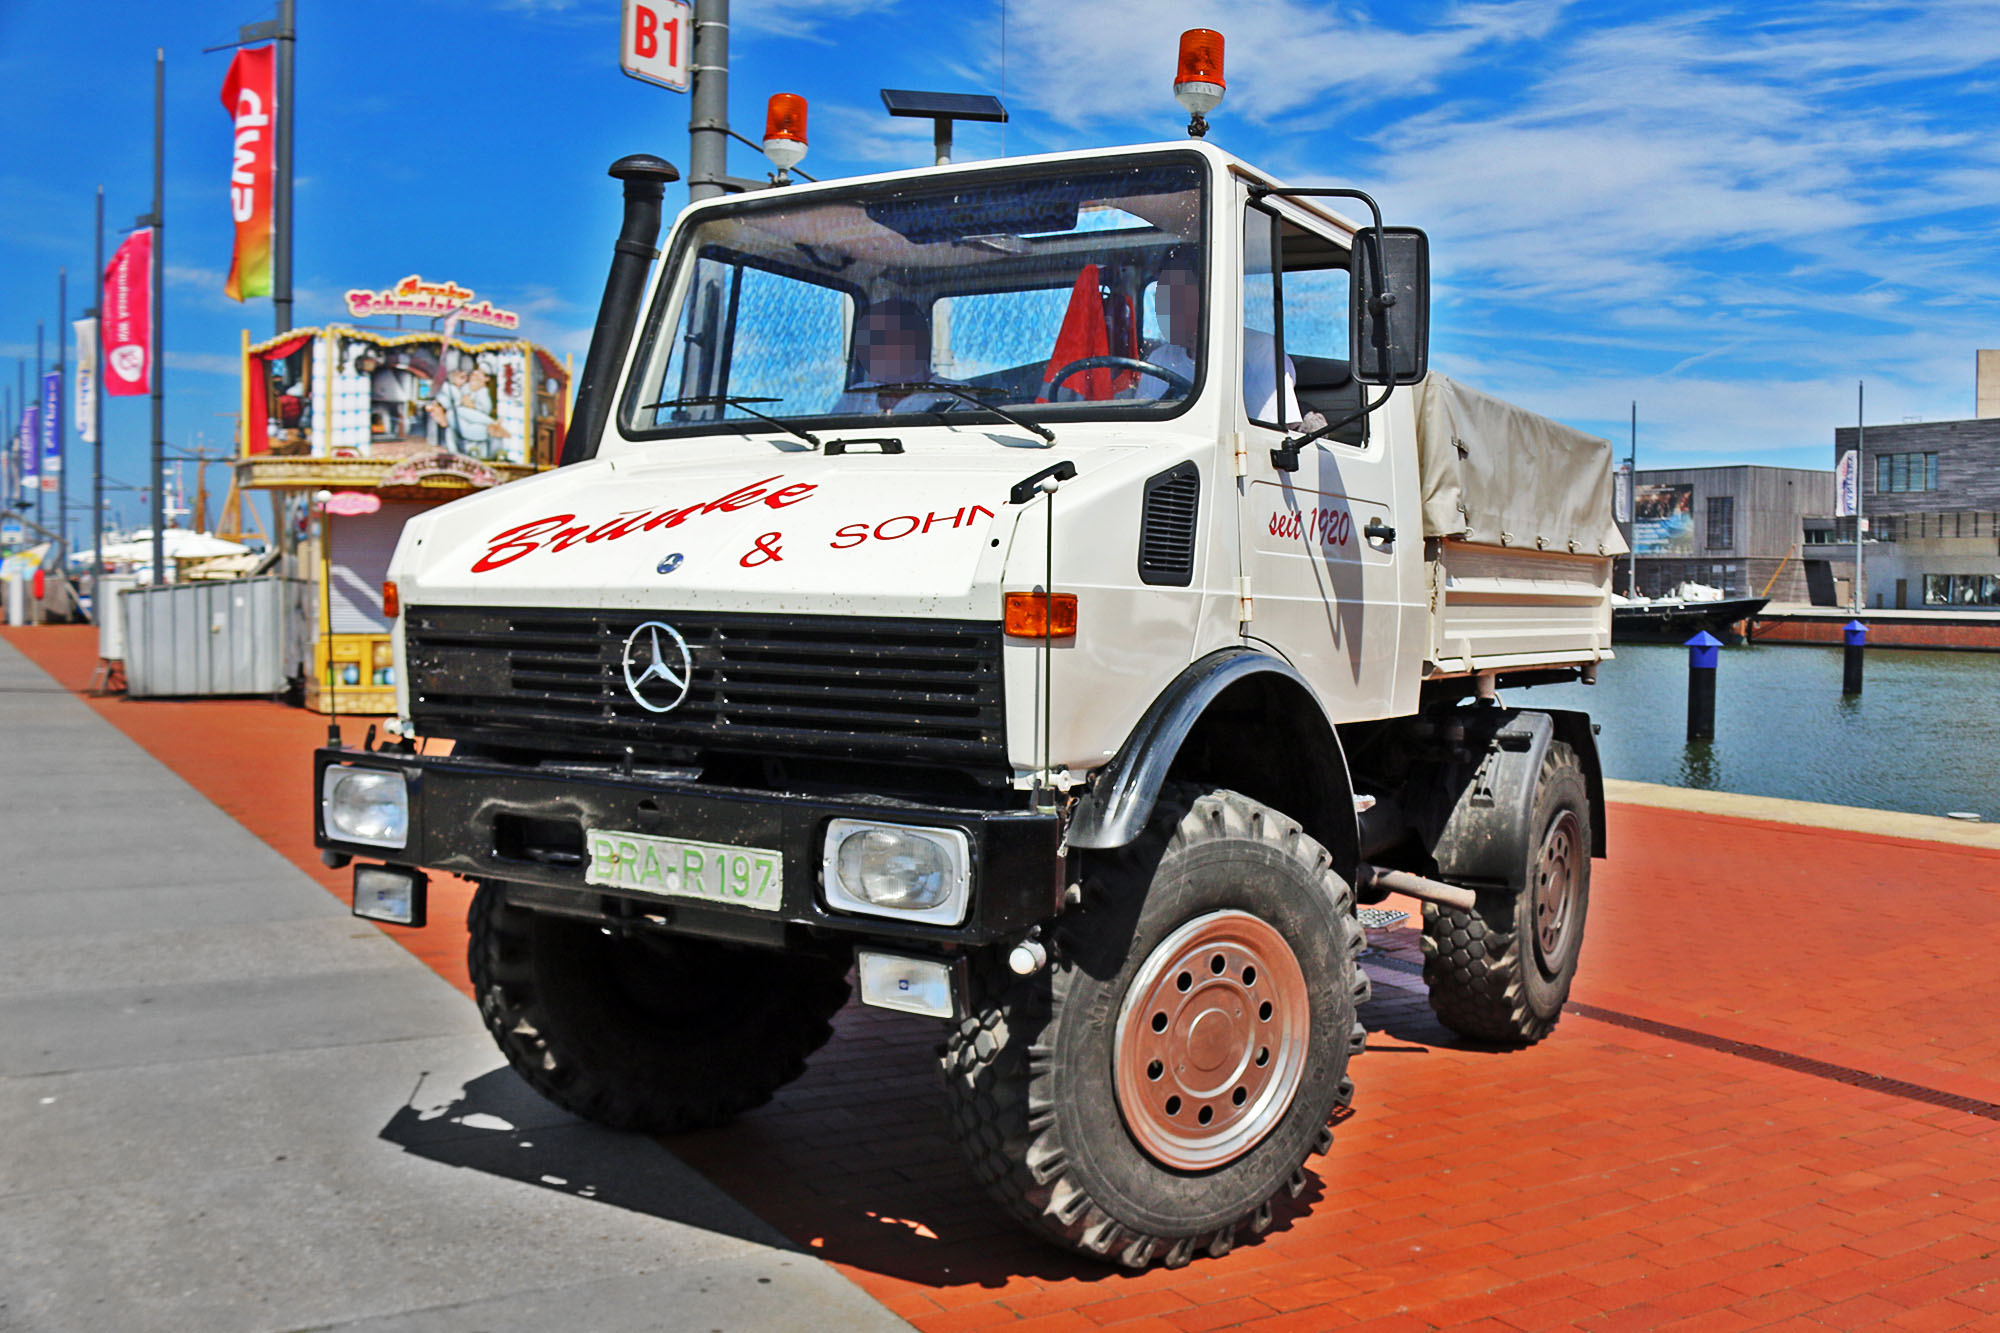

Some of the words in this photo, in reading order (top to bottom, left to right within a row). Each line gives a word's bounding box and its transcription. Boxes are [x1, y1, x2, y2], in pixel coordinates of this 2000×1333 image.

[635, 4, 678, 68] B1
[740, 532, 783, 568] &
[1269, 510, 1302, 540] seit
[1309, 507, 1350, 546] 1920
[595, 839, 704, 893] BRA-R
[716, 854, 774, 898] 197
